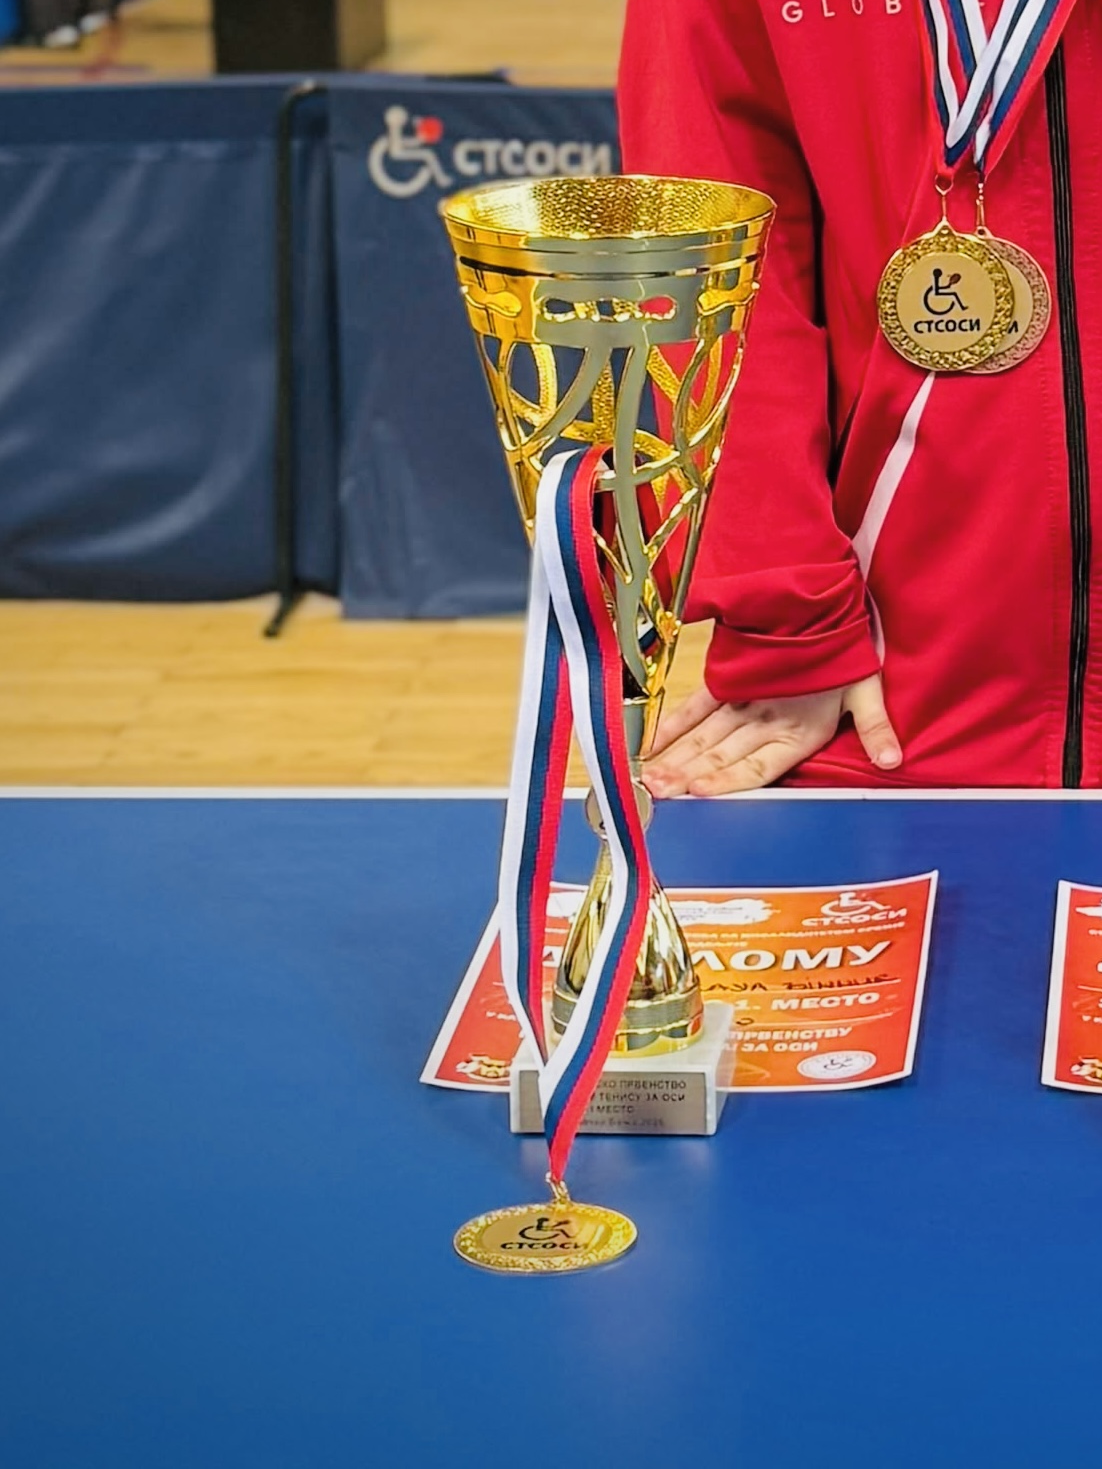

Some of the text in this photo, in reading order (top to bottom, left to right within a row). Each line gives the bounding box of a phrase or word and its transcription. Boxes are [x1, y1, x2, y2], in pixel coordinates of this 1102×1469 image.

[453, 139, 612, 176] СТСОСИ
[913, 318, 980, 334] СТСОСИ
[801, 908, 908, 927] СТСОСИ
[771, 992, 880, 1011] МЕСТО
[741, 1041, 769, 1052] ЗА
[773, 1041, 818, 1052] ОСИ
[620, 1080, 687, 1090] ПРВЕНСТВО
[662, 1093, 686, 1102] ОСИ
